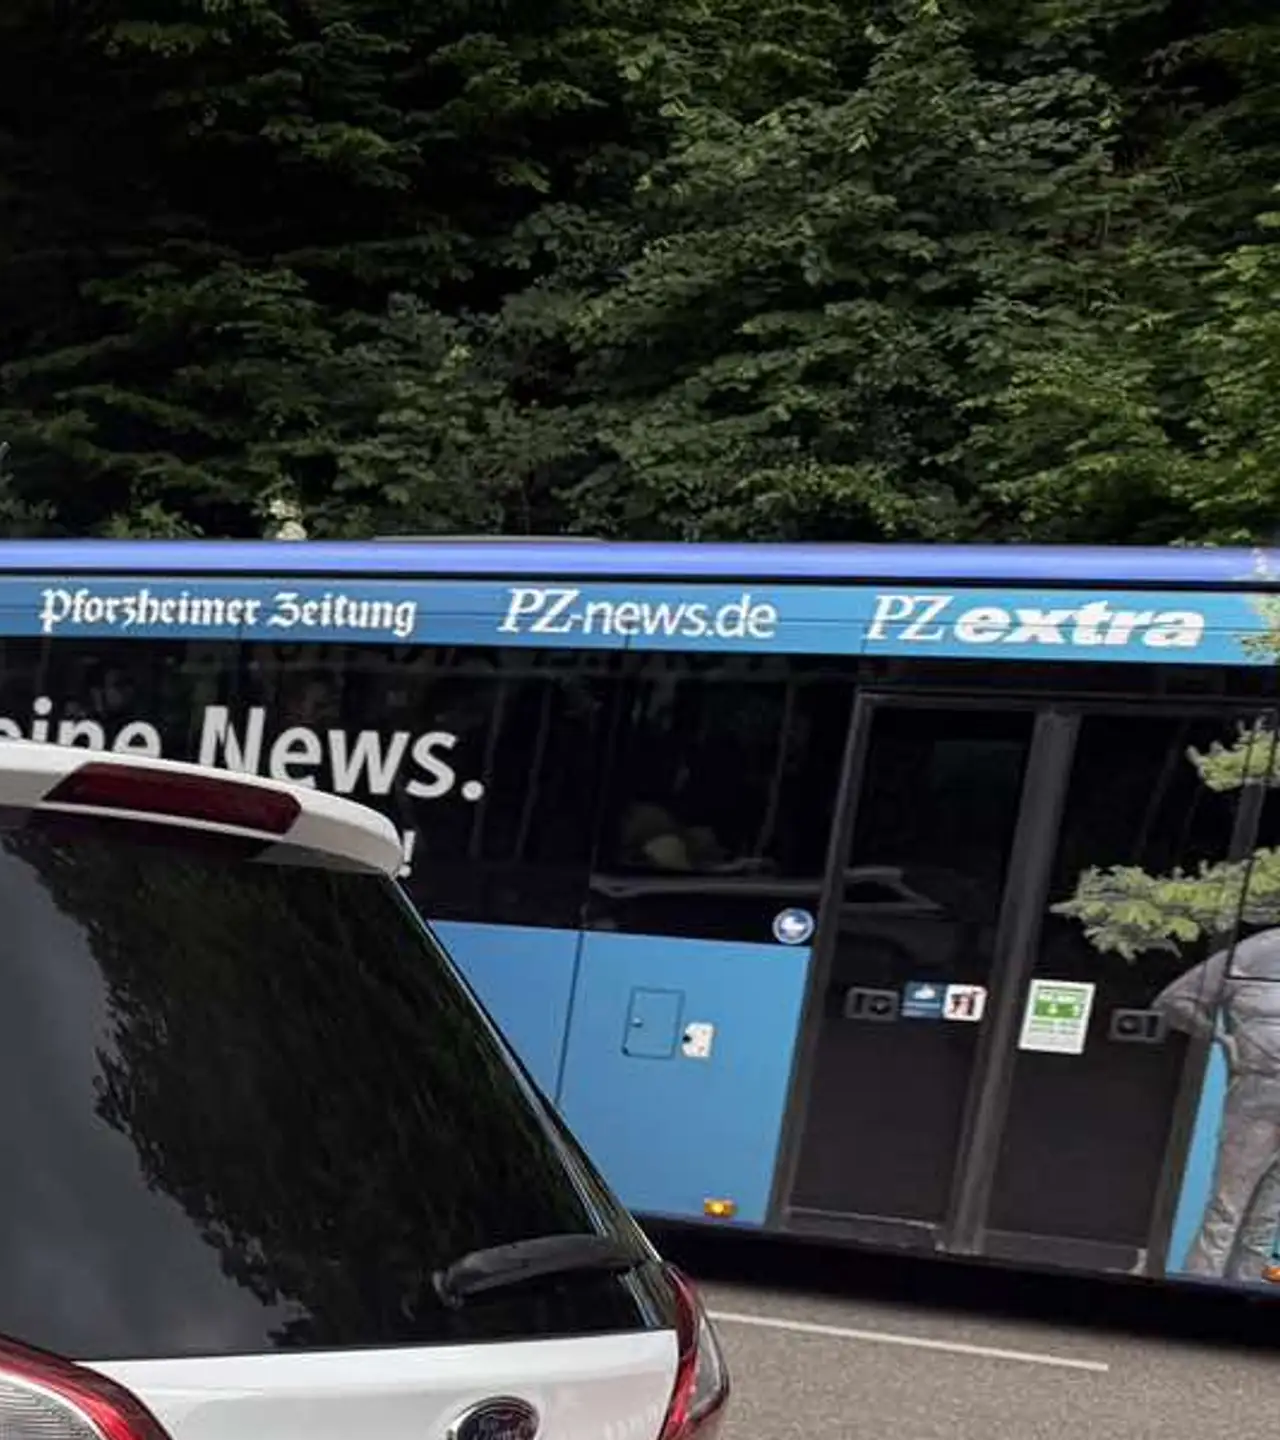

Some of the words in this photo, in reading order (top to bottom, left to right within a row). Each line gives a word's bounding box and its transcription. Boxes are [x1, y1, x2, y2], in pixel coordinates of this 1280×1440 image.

[39, 588, 262, 633] Pforzheimer
[266, 592, 418, 638] Zeitung
[198, 704, 485, 800] News.
